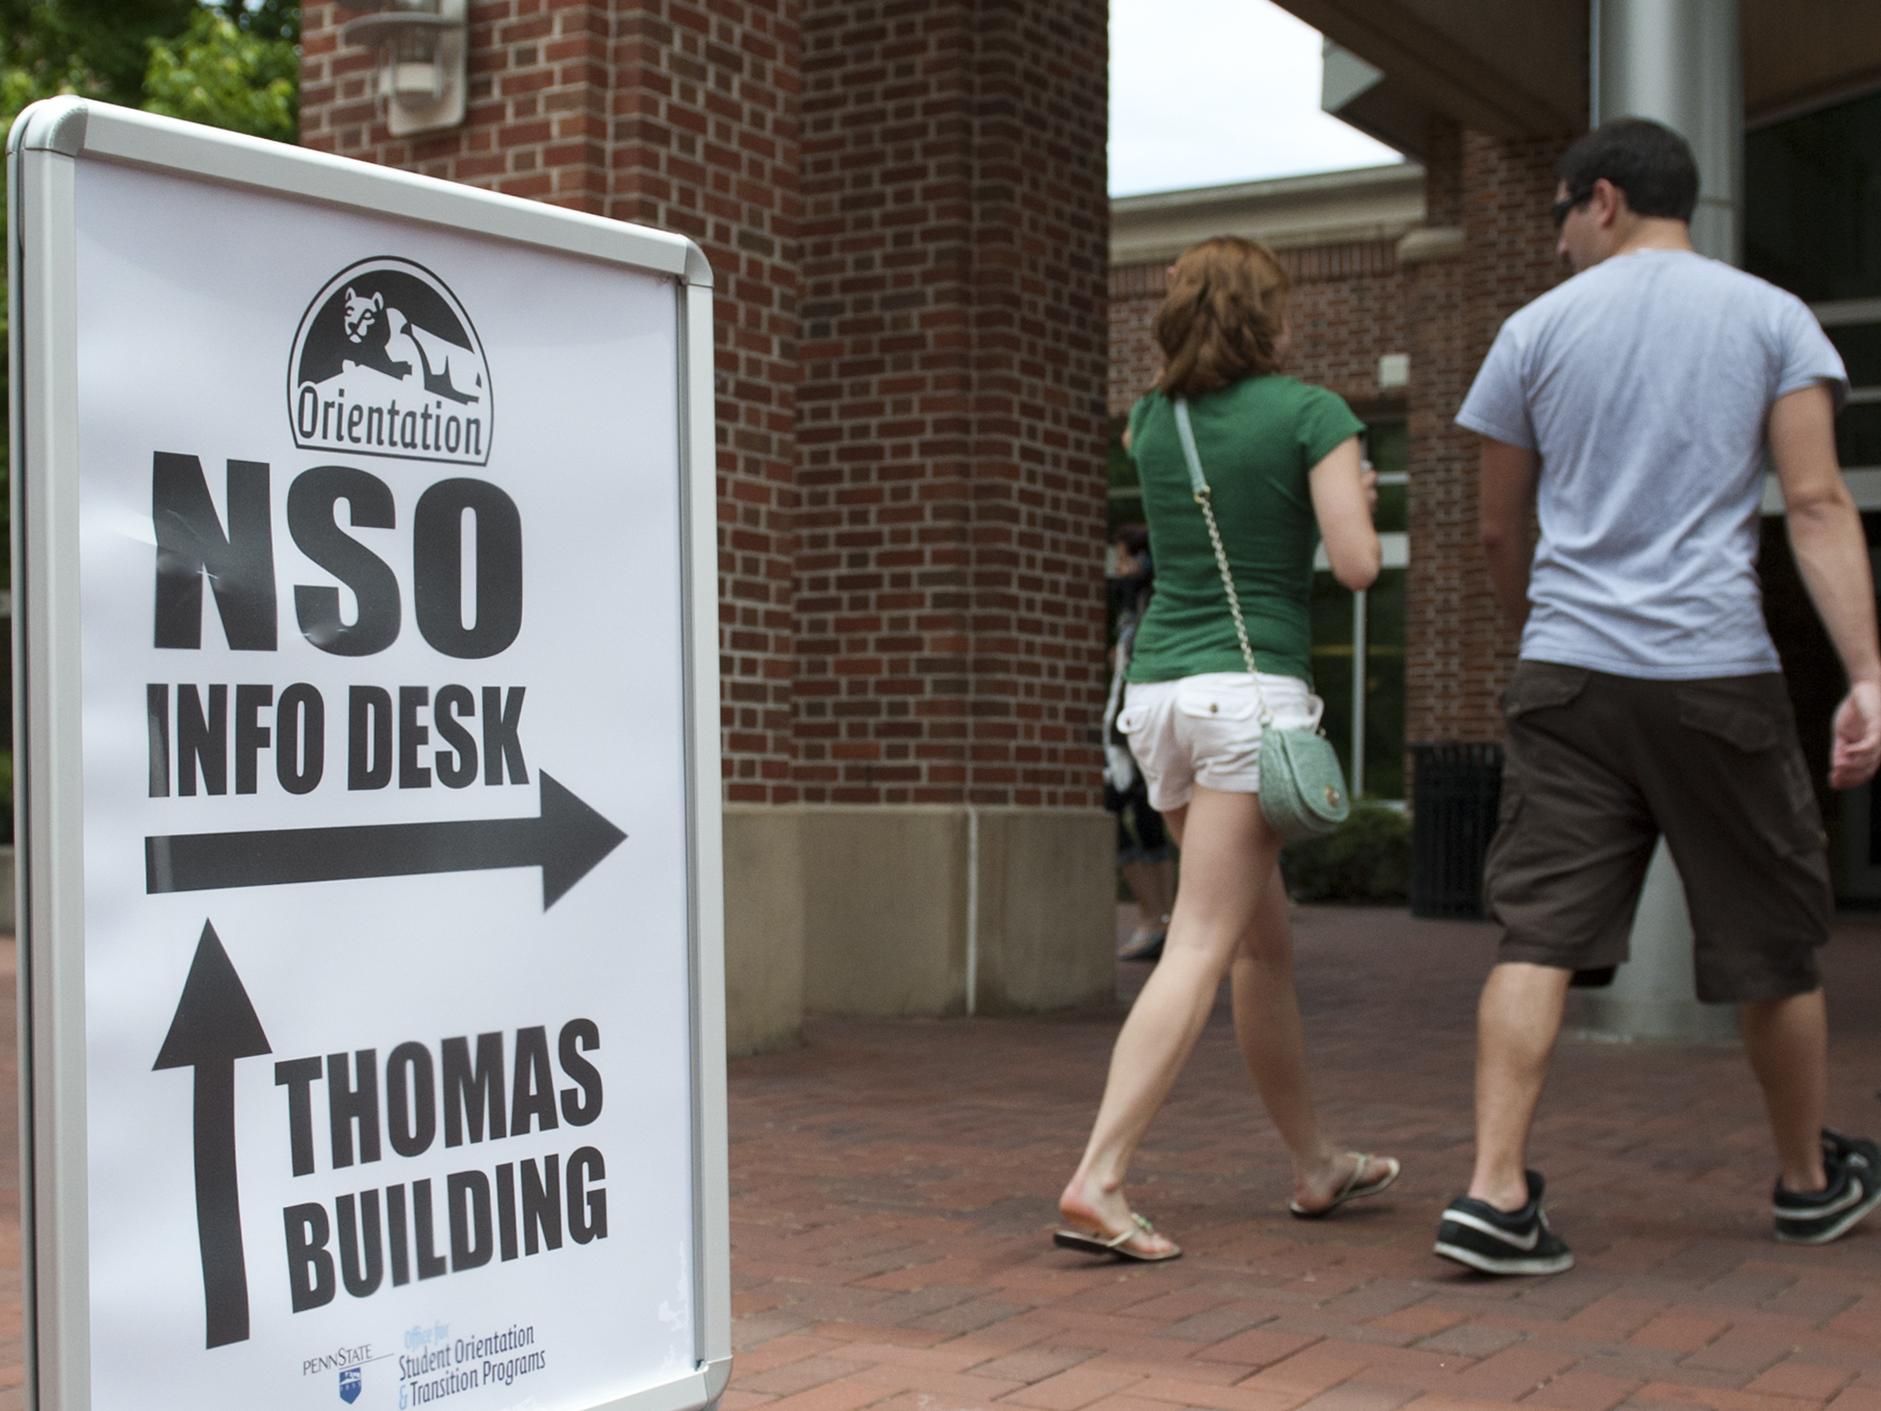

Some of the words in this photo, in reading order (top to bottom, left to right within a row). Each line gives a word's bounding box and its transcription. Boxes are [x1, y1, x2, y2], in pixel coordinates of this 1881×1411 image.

[299, 384, 482, 456] Orientation
[152, 450, 523, 660] NSO
[146, 682, 325, 798] INFO
[347, 683, 530, 792] DESK
[274, 1017, 604, 1178] THOMAS
[282, 1145, 608, 1314] BUILDING
[399, 1346, 451, 1381] Student
[454, 1325, 535, 1364] Orientation
[409, 1366, 479, 1407] Transition
[482, 1349, 546, 1386] Programs
